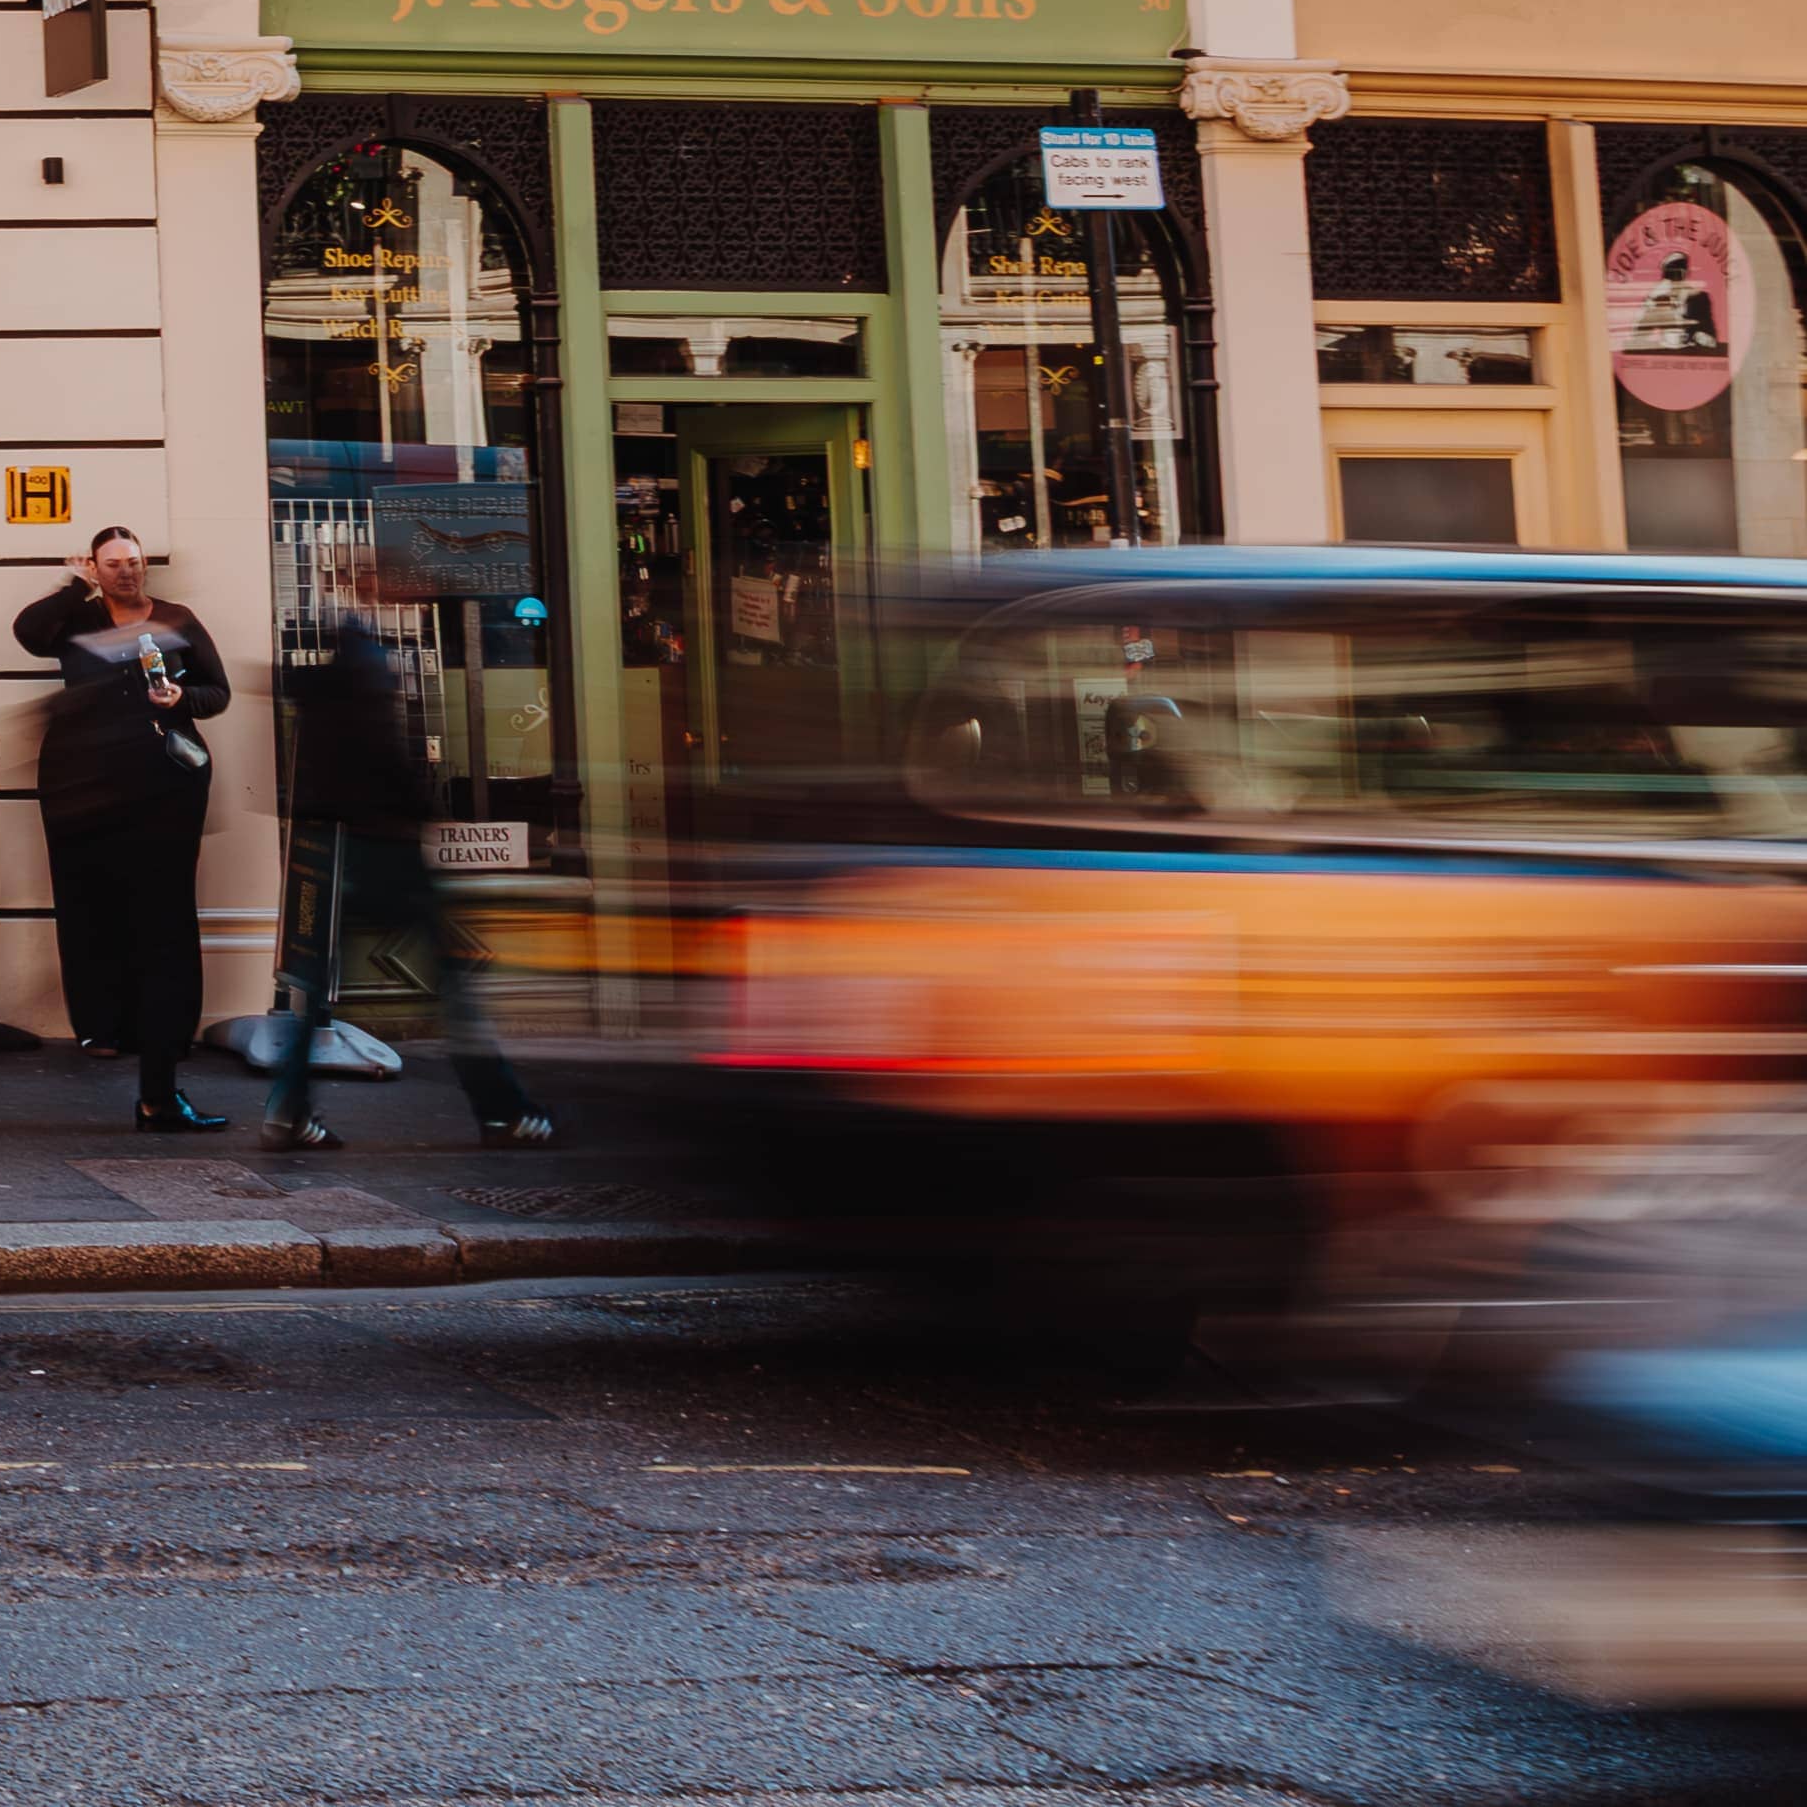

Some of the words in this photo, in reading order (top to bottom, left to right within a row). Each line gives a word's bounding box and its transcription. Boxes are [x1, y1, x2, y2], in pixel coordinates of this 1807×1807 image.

[1050, 154, 1091, 169] Cabs
[1096, 156, 1113, 168] to
[1117, 155, 1151, 169] rank
[1057, 172, 1105, 188] facing
[1110, 174, 1149, 186] west
[1663, 217, 1700, 242] THE
[323, 247, 375, 269] Shoe
[1039, 255, 1087, 280] Repa
[438, 827, 510, 843] TRAINERS
[438, 847, 511, 863] CLEANING
